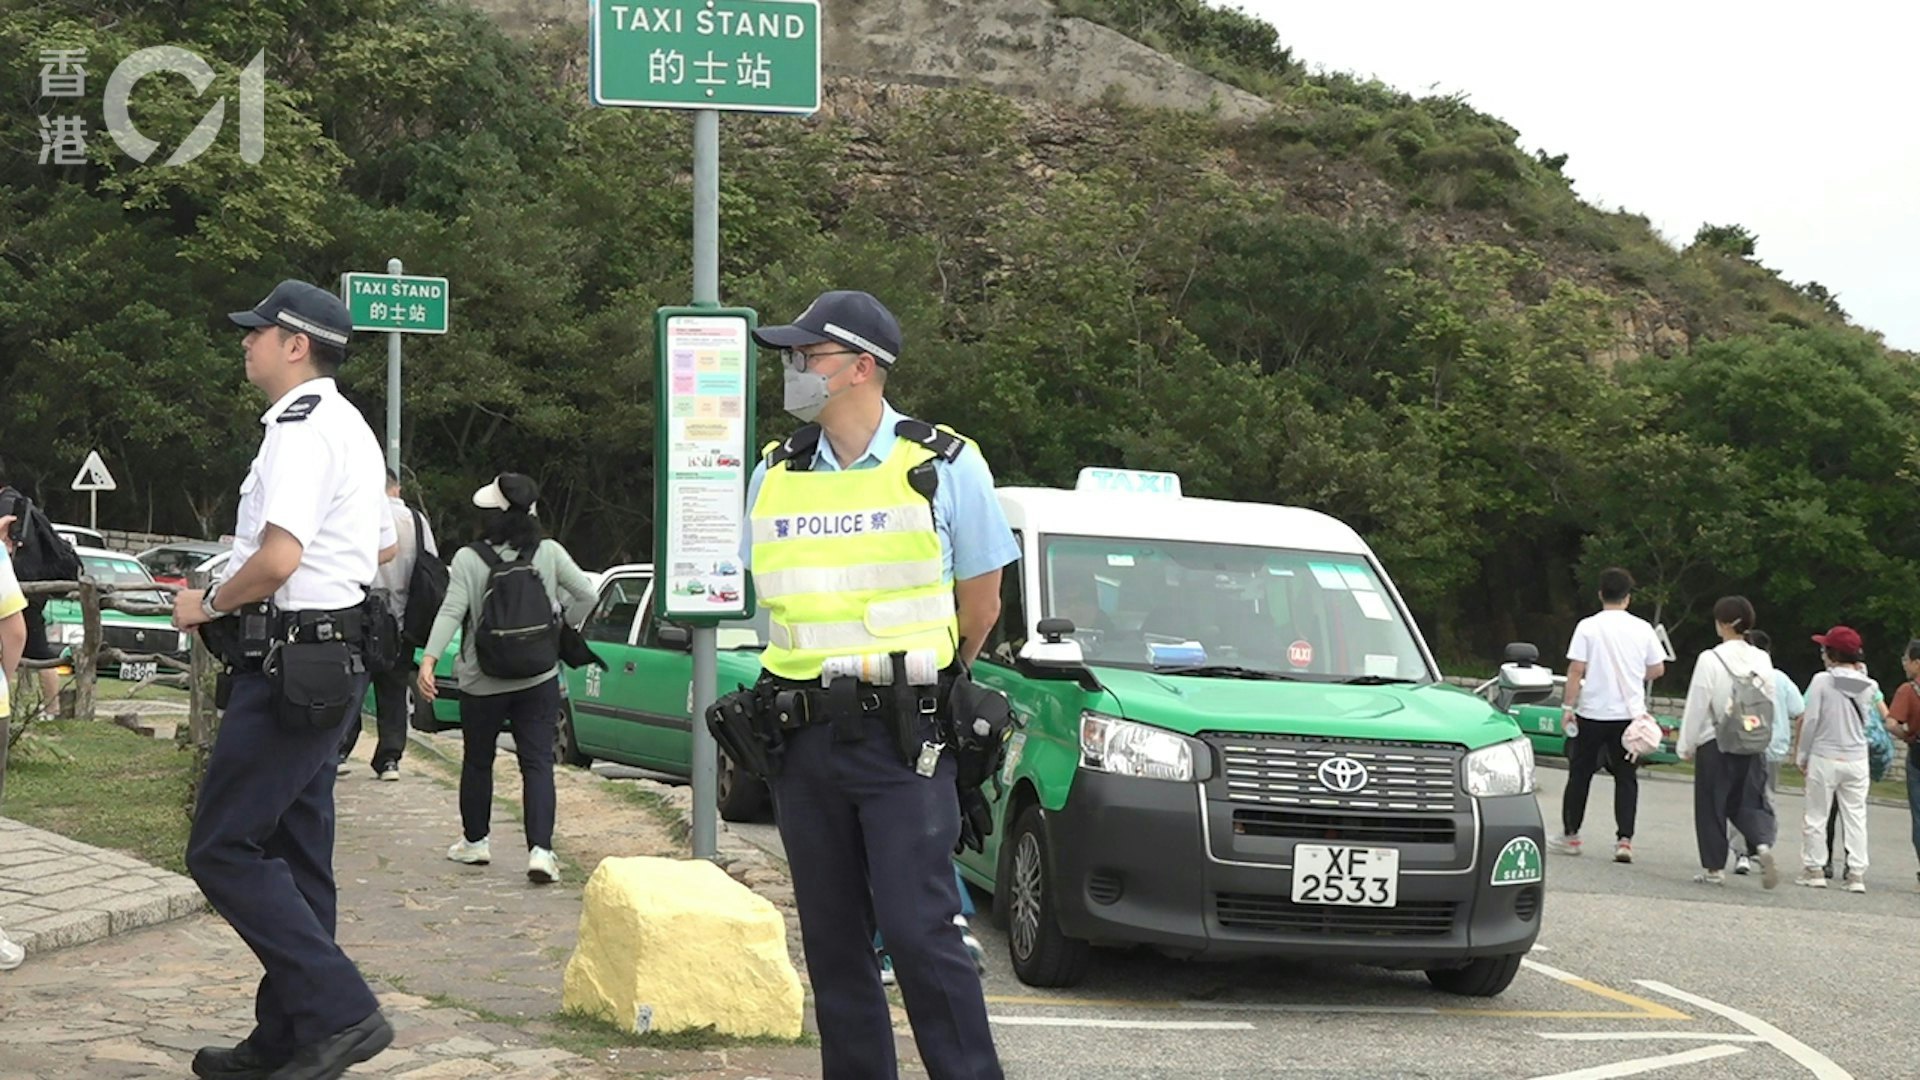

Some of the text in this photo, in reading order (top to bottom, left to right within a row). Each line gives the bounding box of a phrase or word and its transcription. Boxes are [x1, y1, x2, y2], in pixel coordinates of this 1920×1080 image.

[611, 6, 805, 39] TAXI STAND
[649, 48, 772, 89] 的士站
[354, 281, 441, 298] TAXI STAND
[370, 302, 426, 323] 的士站
[1091, 471, 1173, 493] TAXI
[774, 511, 888, 537] 警 POLICE 察
[1291, 647, 1311, 661] TAXI
[1508, 842, 1535, 855] TAXI
[1325, 848, 1368, 875] XF
[1517, 851, 1526, 869] 4
[1503, 868, 1536, 880] SEATS
[1300, 874, 1389, 904] 2533
